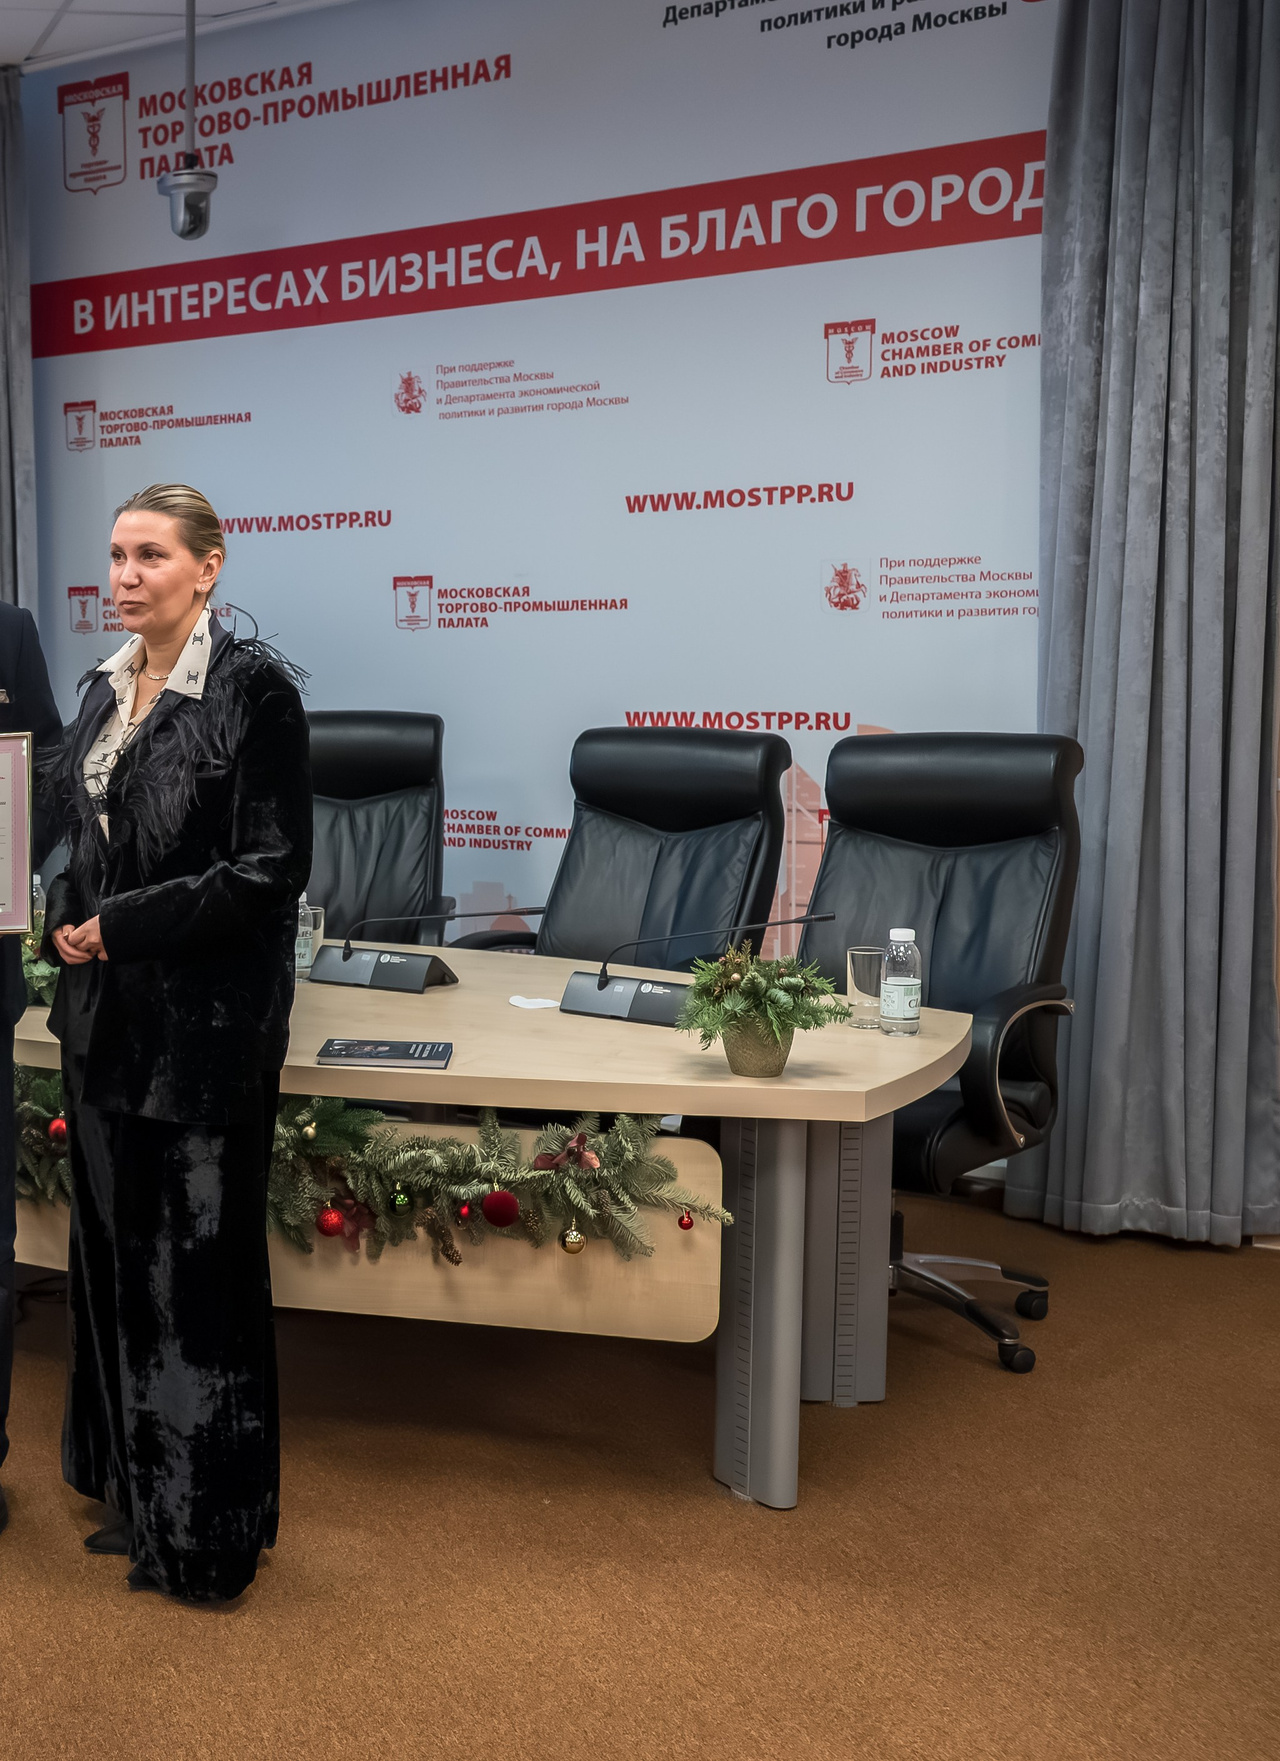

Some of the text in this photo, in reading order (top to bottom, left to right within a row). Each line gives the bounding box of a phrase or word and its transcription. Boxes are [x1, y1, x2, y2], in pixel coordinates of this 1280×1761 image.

[760, 0, 865, 32] политики
[826, 22, 906, 49] города
[911, 2, 1007, 32] Москвы
[138, 54, 512, 149] ТОРОВО-ПРОМЫШЛЕННАЯ
[73, 299, 95, 335] В
[104, 265, 330, 332] ИНТЕРЕСАХ
[340, 235, 561, 302] БИЗНЕСА,
[576, 221, 645, 270] НА
[660, 193, 838, 259] БЛАГО
[881, 325, 960, 345] MOSCOW
[880, 333, 1041, 362] CHAMBER OF COM
[436, 358, 515, 375] При поддержке
[880, 364, 916, 379] AND
[921, 354, 1007, 375] INDUSTRY
[436, 371, 554, 391] Правительства Москвы
[436, 380, 601, 406] и Департамента экономической
[99, 405, 173, 422] МОСКОВСКАЯ
[438, 395, 629, 420] политики и развития города Москвы
[99, 411, 252, 435] ТОРГОВО-ПРОМЫШЛЕННАЯ
[100, 435, 142, 448] ПАЛАТА
[625, 482, 855, 514] WWW.MOSTPP.RU
[219, 510, 392, 534] WWW.MOSTPP.RU
[879, 555, 982, 571] При поддержке
[879, 570, 1033, 588] Правительства Москвы
[437, 586, 530, 599] МОСКОВСКАЯ
[879, 594, 887, 602] и
[889, 589, 982, 604] Департамента
[437, 598, 628, 614] ТОРГОВО-ПРОМЫШЛЕННАЯ
[882, 606, 1039, 620] политики и развития го
[438, 616, 489, 629] ПАЛАТА
[625, 711, 851, 731] WWW.MOSTPP.RU
[443, 822, 501, 836] HAMBER
[504, 826, 521, 836] OF
[470, 838, 533, 851] INDUSTRY
